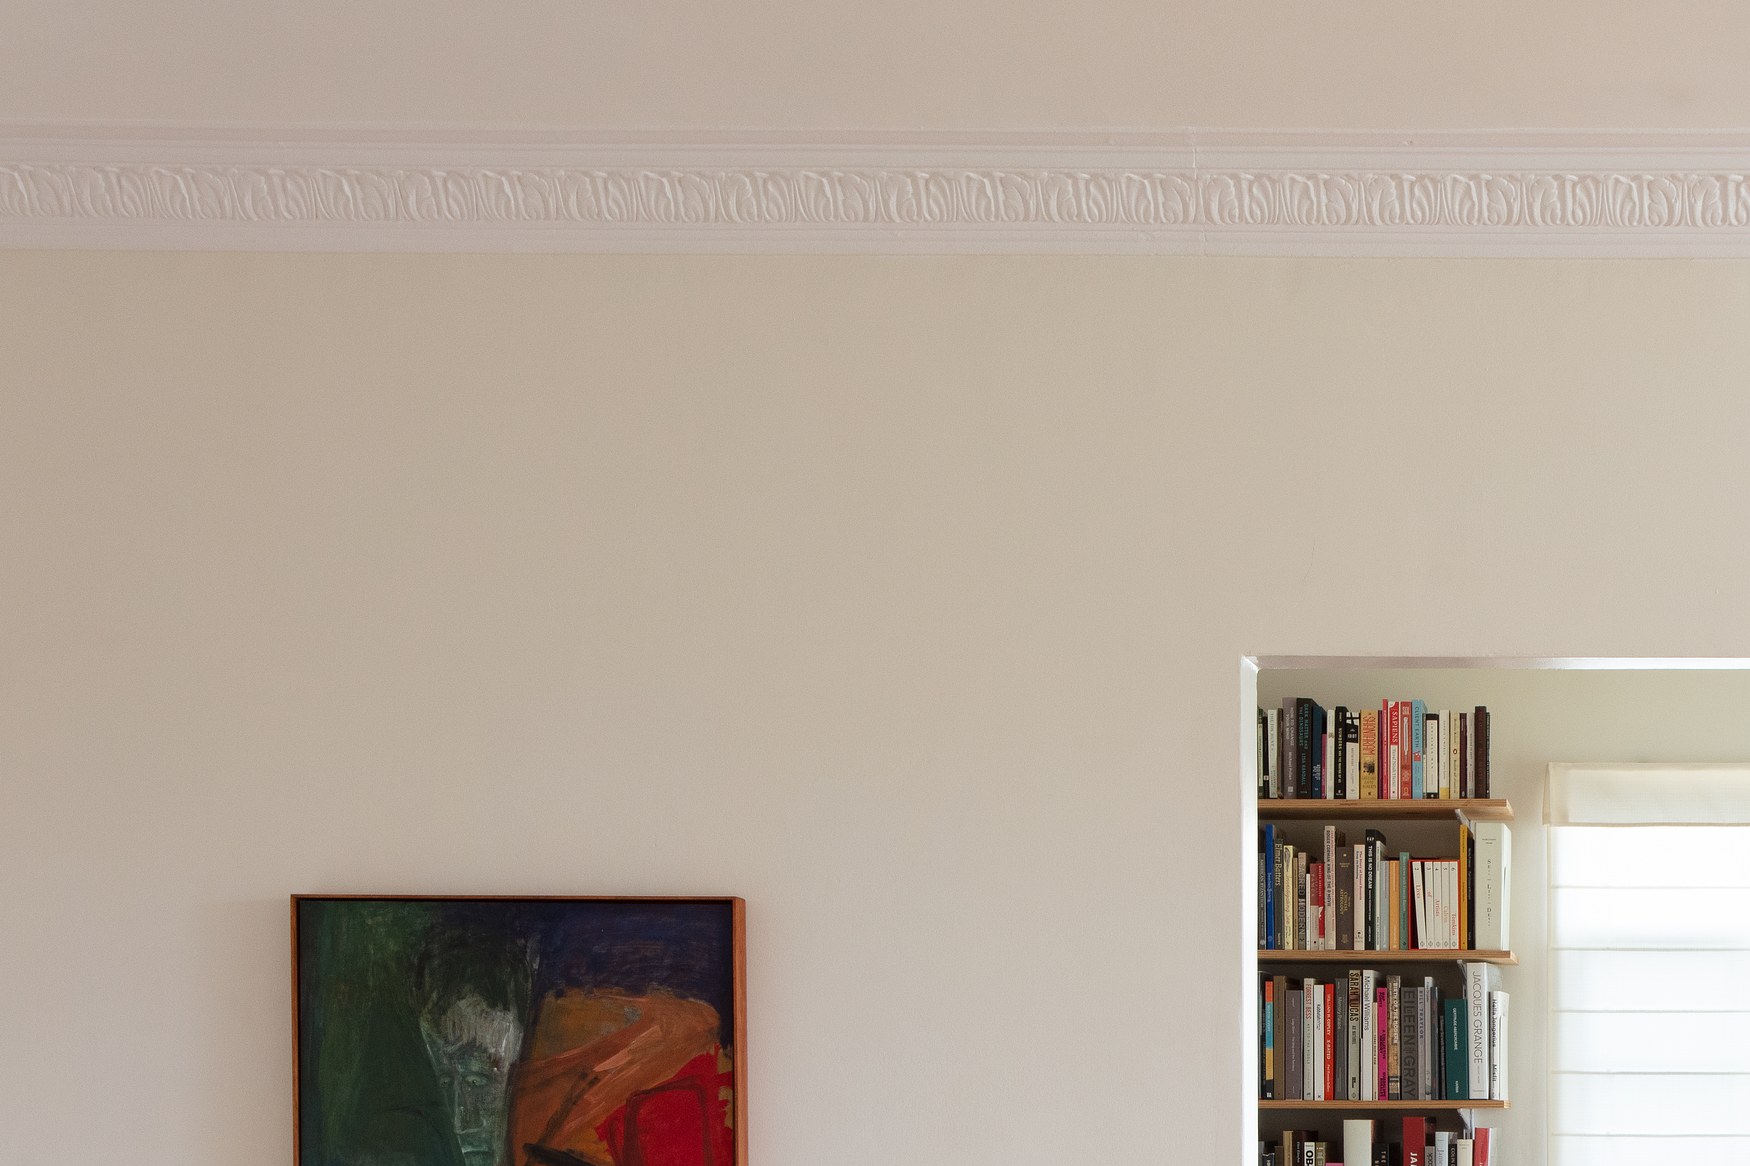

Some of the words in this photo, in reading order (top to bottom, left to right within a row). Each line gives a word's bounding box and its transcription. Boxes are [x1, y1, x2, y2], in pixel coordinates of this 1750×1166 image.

[1363, 716, 1376, 756] SHANTARAM
[1350, 973, 1359, 996] SARAH
[1472, 971, 1482, 1016] JACQUES
[1350, 997, 1359, 1022] LUCAS
[1403, 991, 1415, 1045] EILEEN
[1473, 1019, 1483, 1064] GRANGE
[1403, 1055, 1415, 1097] GRAY
